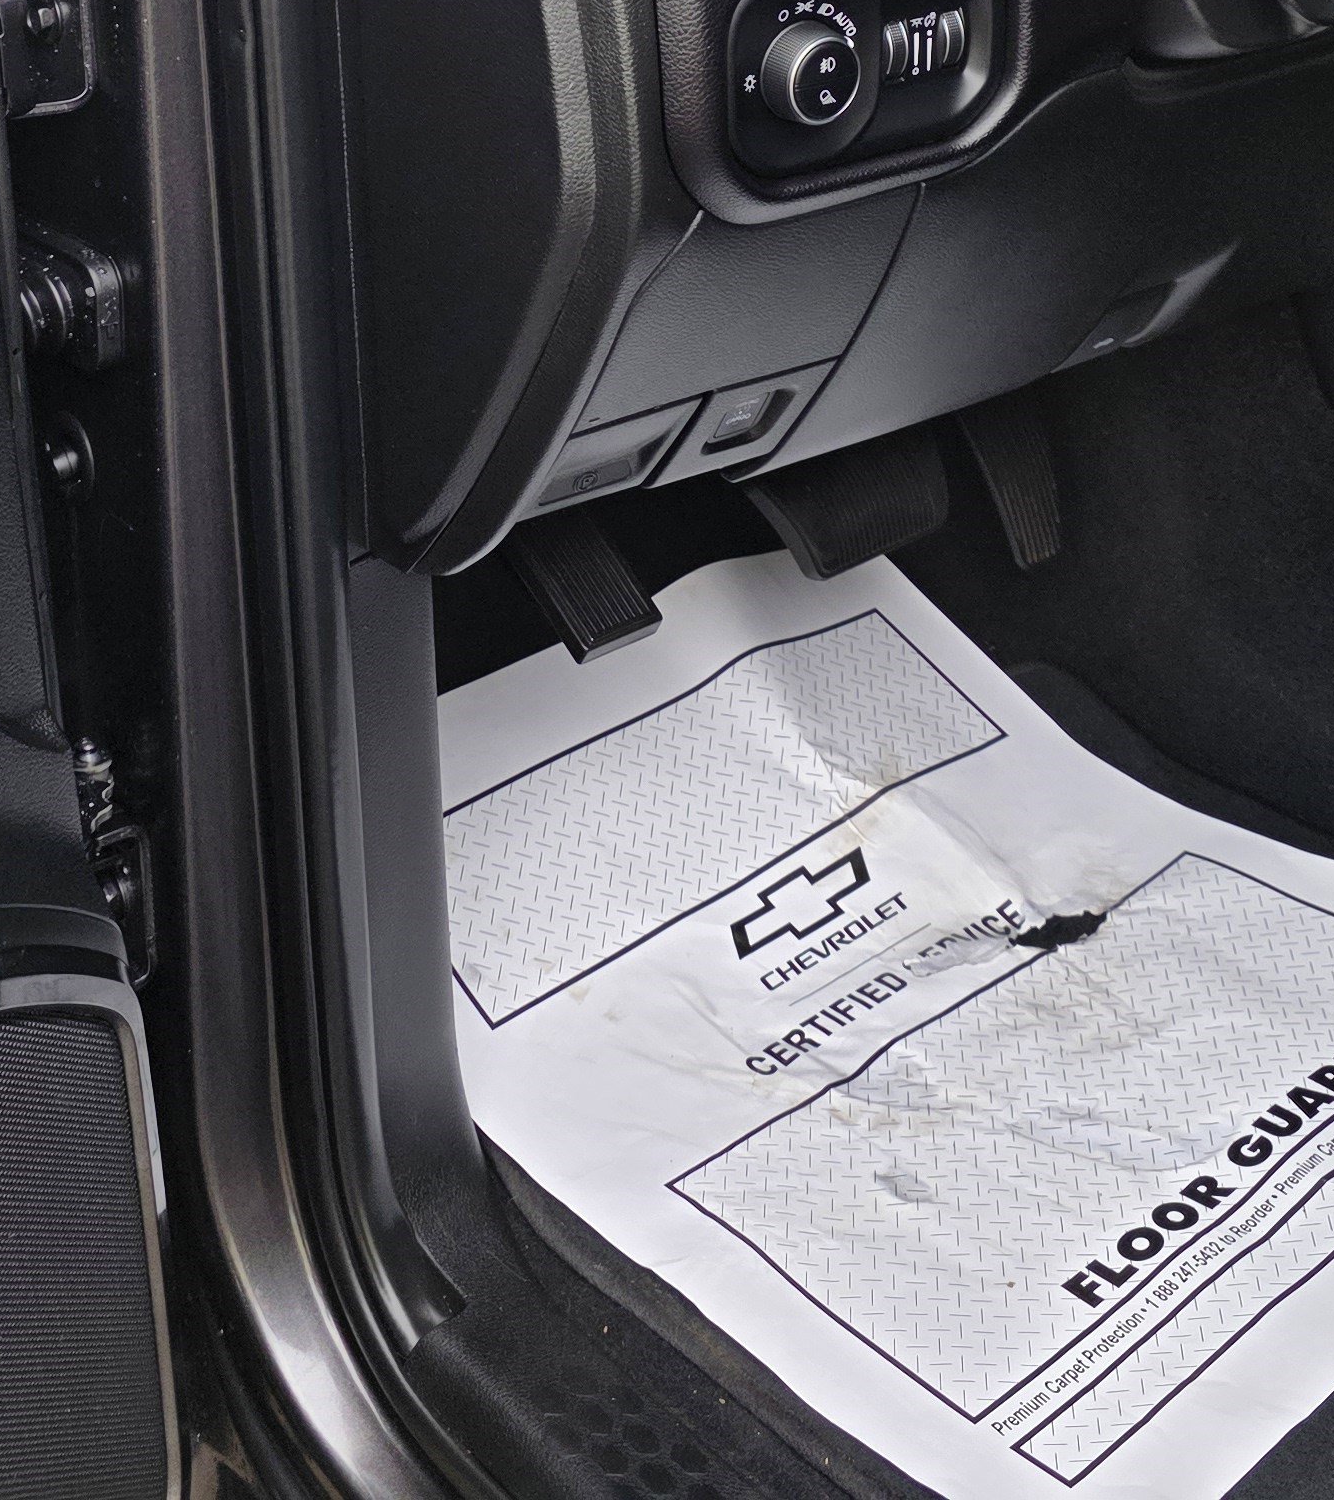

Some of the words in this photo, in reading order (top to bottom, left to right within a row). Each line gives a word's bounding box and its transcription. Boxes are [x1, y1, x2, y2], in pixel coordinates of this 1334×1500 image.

[832, 13, 858, 37] AUTO
[760, 892, 907, 991] CHEVROLET
[745, 972, 908, 1076] CERTIFIED
[1060, 1175, 1238, 1308] FLOOR
[991, 1392, 1051, 1437] Premium
[1045, 1358, 1090, 1394] Carpet
[1082, 1312, 1145, 1364] Protection
[1145, 1297, 1159, 1309] 1
[1153, 1280, 1179, 1301] 888
[1172, 1241, 1225, 1283] 247-5432
[1219, 1232, 1236, 1245] to
[1229, 1198, 1275, 1239] Reorder
[1274, 1153, 1325, 1196] Premium
